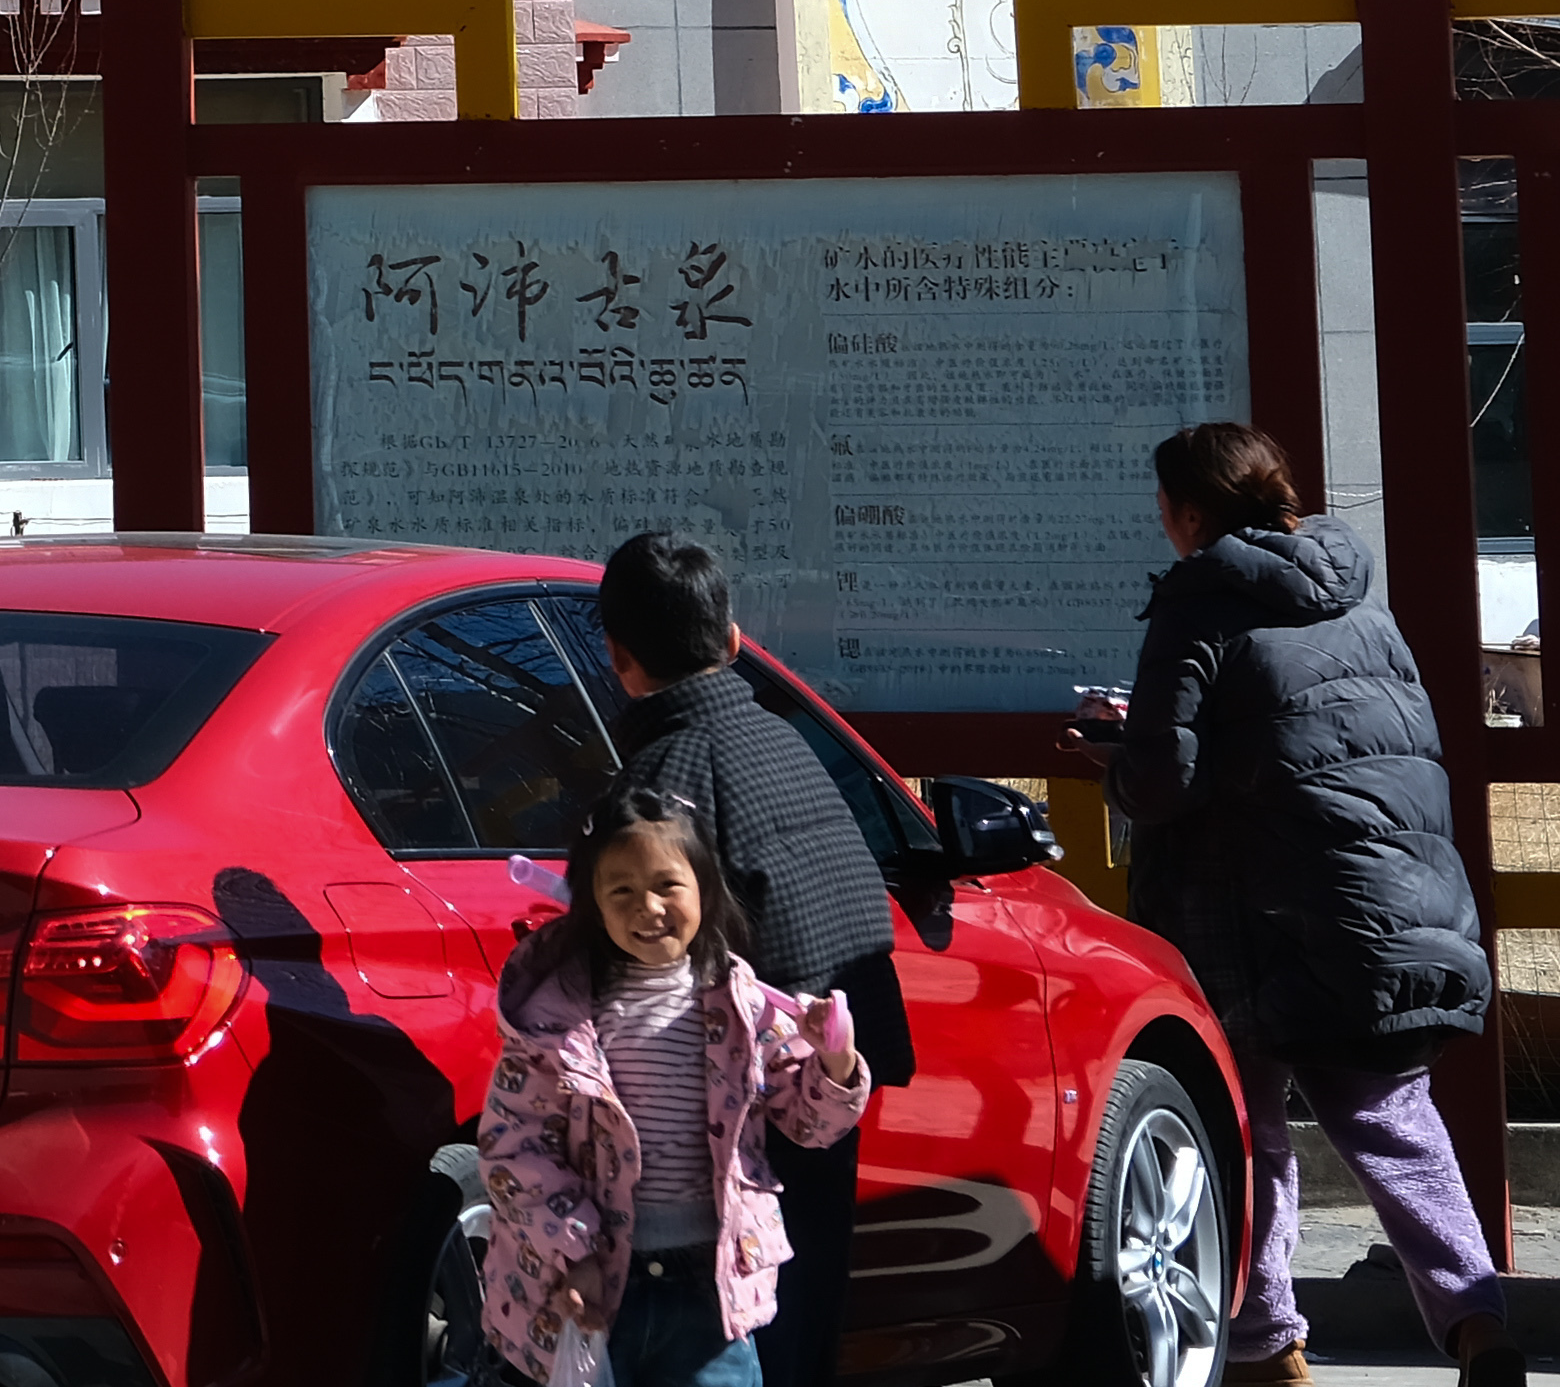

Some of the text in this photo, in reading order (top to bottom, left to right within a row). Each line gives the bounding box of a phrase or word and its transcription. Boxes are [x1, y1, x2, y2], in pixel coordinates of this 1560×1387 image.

[362, 240, 754, 342] 阿沛古泉
[827, 332, 897, 355] 偏硅酸
